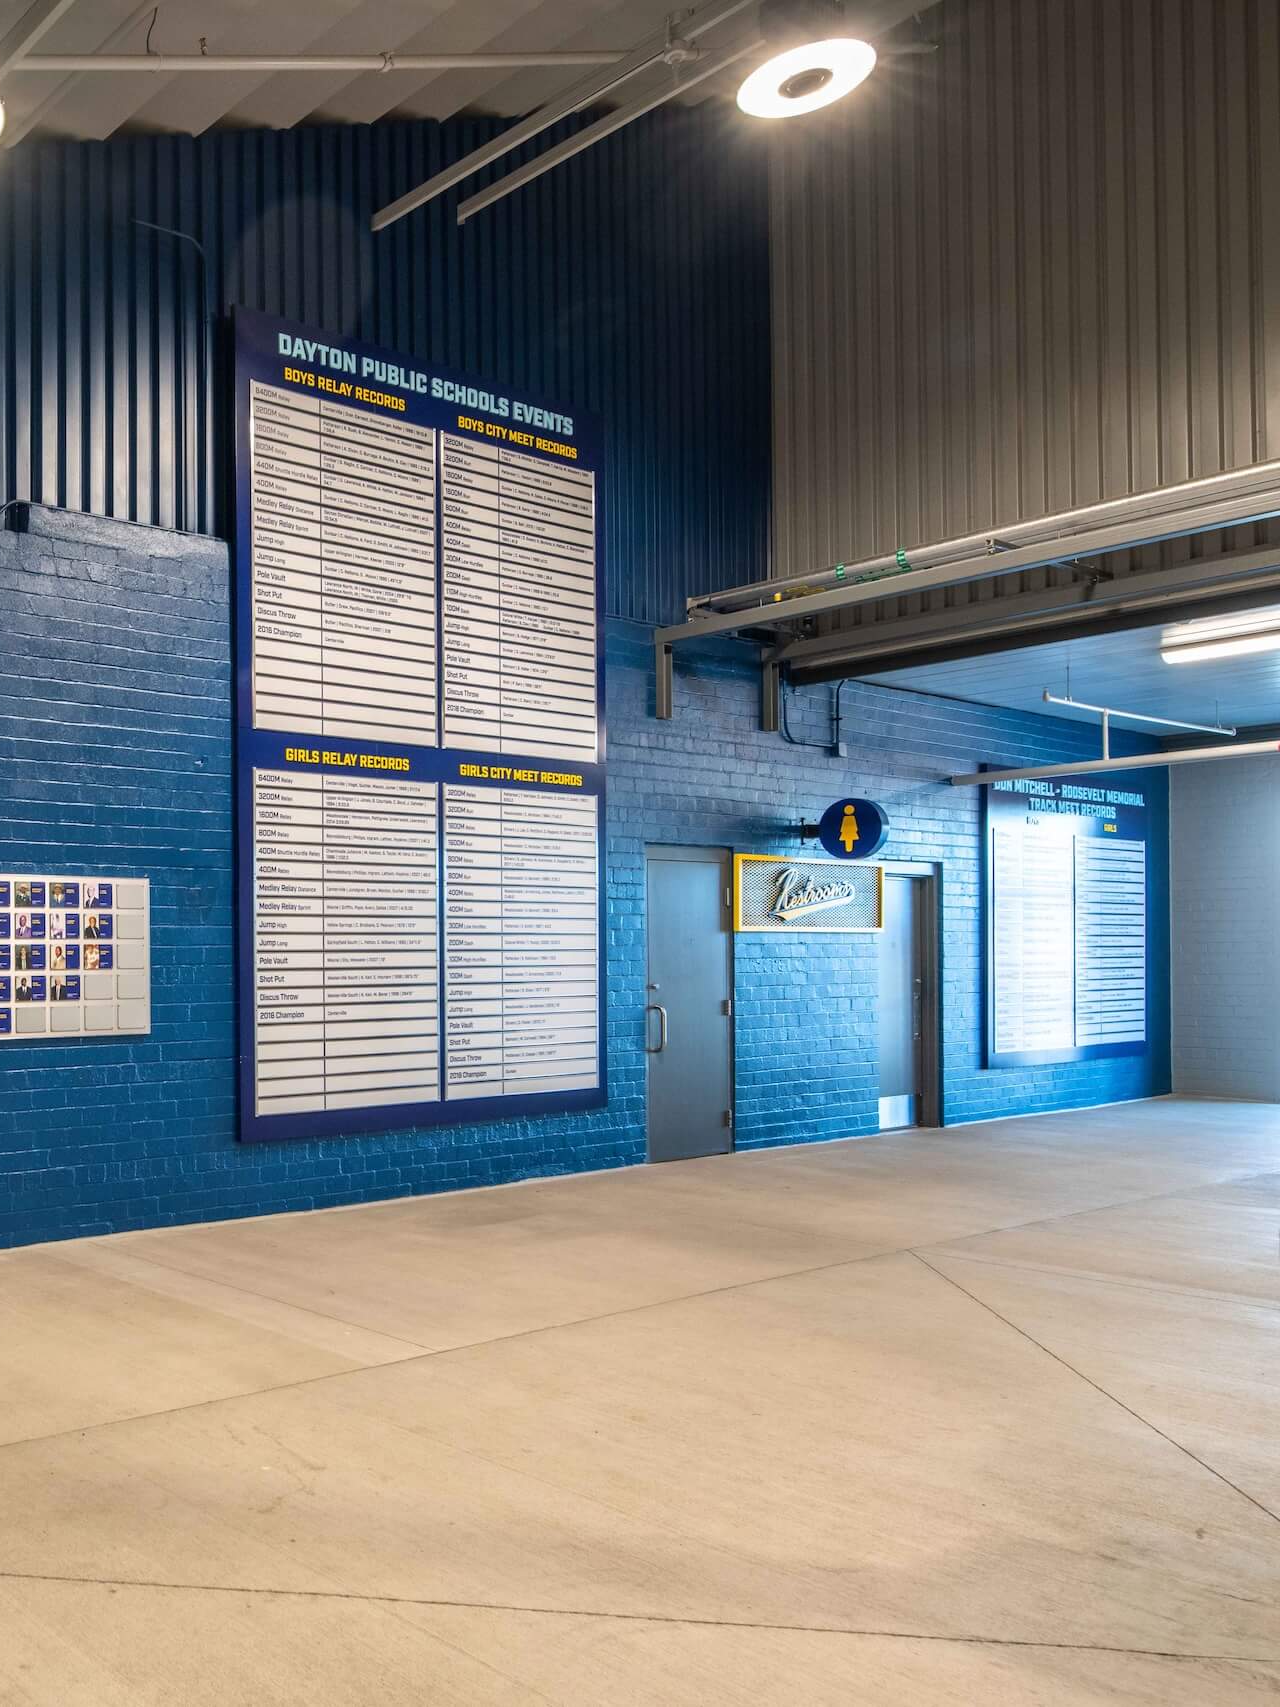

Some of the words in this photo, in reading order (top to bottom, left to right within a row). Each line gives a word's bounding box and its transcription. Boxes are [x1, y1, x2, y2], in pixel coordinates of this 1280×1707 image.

[279, 333, 357, 375] DAYTON
[362, 356, 427, 394] PUBLIC
[432, 377, 509, 418] SCHOOLS
[513, 402, 574, 435] EVENTS
[284, 367, 315, 388] BOYS
[318, 377, 353, 397] RELAY
[355, 387, 406, 412] RECORDS
[458, 416, 484, 433] BOYS
[486, 422, 507, 440] CITY
[509, 429, 534, 447] MEET
[536, 438, 577, 459] RECORDS
[445, 438, 463, 448] 3200M
[445, 455, 463, 464] 3200M
[256, 480, 274, 488] 400M
[256, 498, 278, 508] Medley
[257, 516, 278, 527] Medley
[257, 534, 273, 543] Jump
[257, 552, 273, 561] Jump
[257, 570, 270, 578] Pole
[270, 572, 285, 581] Vault
[257, 588, 271, 597] Shot
[258, 607, 277, 616] Discus
[278, 610, 296, 619] Throw
[446, 622, 460, 630] Jump
[273, 628, 302, 638] Champion
[446, 638, 460, 647] Jump
[447, 654, 458, 662] Pole
[447, 671, 458, 679] Shot
[459, 672, 467, 680] Put
[447, 688, 462, 696] Discus
[460, 706, 484, 714] Champion
[286, 748, 320, 763] GIRLS
[322, 752, 357, 767] RELAY
[359, 755, 409, 771] RECORDS
[460, 764, 489, 778] GIRLS
[490, 767, 511, 780] CITY
[514, 770, 539, 783] MEET
[541, 772, 583, 787] RECORDS
[1014, 779, 1055, 796] MITCHELL
[1062, 785, 1105, 802] ROOSEVELT
[1107, 791, 1145, 806] MEMORIAL
[1029, 798, 1057, 812] TRACK
[1058, 802, 1080, 815] MEET
[1081, 804, 1116, 818] RECORDS
[258, 829, 276, 837] 800M
[259, 884, 280, 892] Medley
[774, 867, 853, 910] Restrooms
[276, 1011, 304, 1019] Champion
